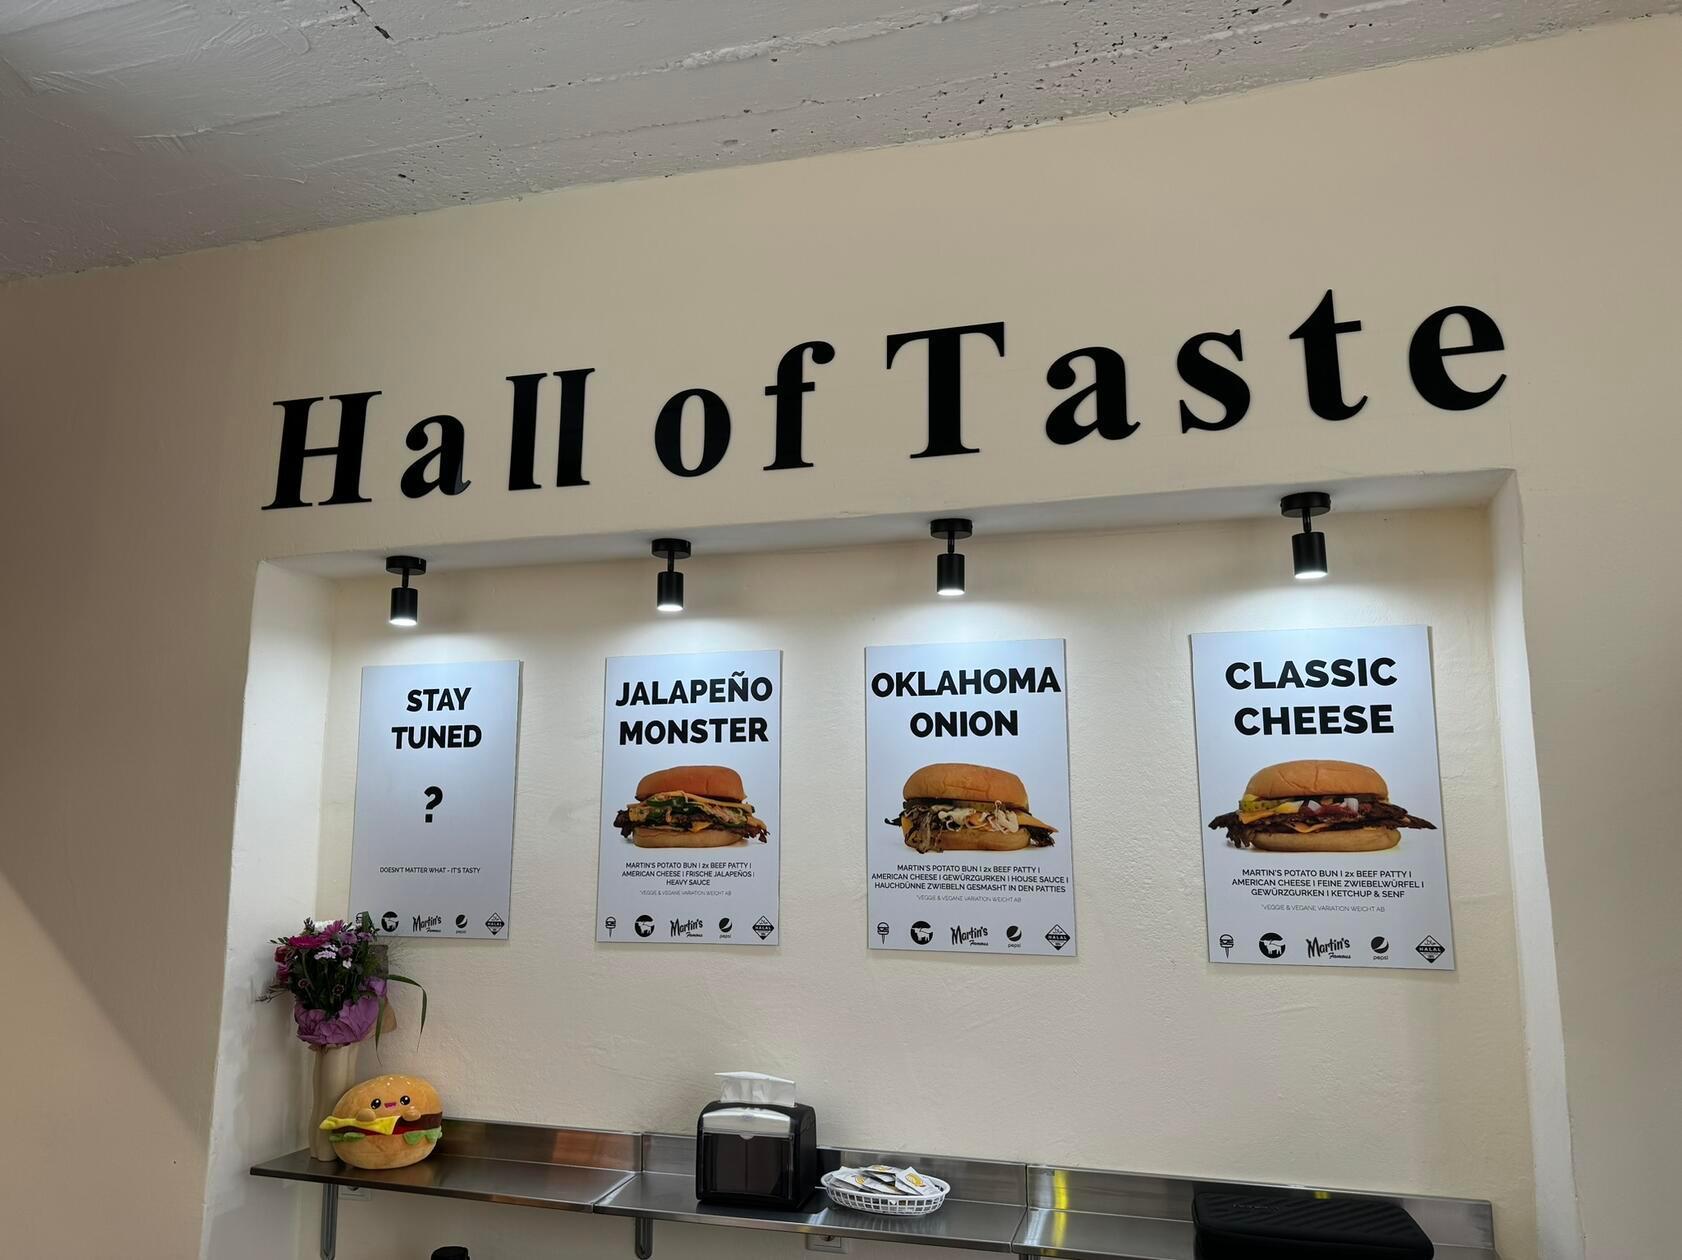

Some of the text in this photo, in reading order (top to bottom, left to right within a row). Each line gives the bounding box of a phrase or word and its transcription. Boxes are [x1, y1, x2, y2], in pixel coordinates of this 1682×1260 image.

[261, 287, 1510, 511] Hall of Taste
[871, 667, 1062, 697] OKLAHOMA
[1225, 657, 1398, 690] CLASSIC
[406, 687, 472, 712] STAY
[615, 671, 773, 707] JALAPEÑO
[619, 717, 769, 745] MONSTER
[910, 709, 1018, 738] ONION
[1234, 704, 1395, 736] CHEESE
[391, 724, 482, 750] TUNED
[423, 786, 443, 823] ?
[713, 869, 752, 878] JALAPEÑOS
[897, 864, 931, 872] MARTIN'S
[909, 873, 938, 881] CHEESE
[943, 872, 1006, 882] GEWÜRZGURKEN
[1011, 875, 1038, 883] HOUSE
[1242, 869, 1283, 877] MARTIN'S
[1284, 869, 1318, 878] POTATO
[1319, 870, 1339, 878] BUN
[1356, 870, 1378, 878] BEEF
[1379, 870, 1407, 878] PATTY
[874, 880, 926, 890] HAUCHDÜNNE
[927, 882, 965, 891] ZWIEBELN
[966, 883, 1007, 891] GESMASHT
[1017, 884, 1034, 892] DEN
[1035, 885, 1066, 893] PATTIES
[1231, 878, 1276, 887] AMERICAN
[1277, 879, 1312, 887] CHEESE
[1317, 879, 1342, 888] FEINE
[1344, 878, 1420, 888] ZWIEBELWÜRFEL
[1251, 887, 1325, 897] GEWÜRZGURKEN
[1331, 890, 1372, 898] KETCHUP
[1373, 890, 1380, 898] &
[1382, 890, 1405, 898] SENF
[670, 918, 703, 937] Martin's
[950, 925, 989, 945] Martin's
[1305, 937, 1351, 959] Martin's
